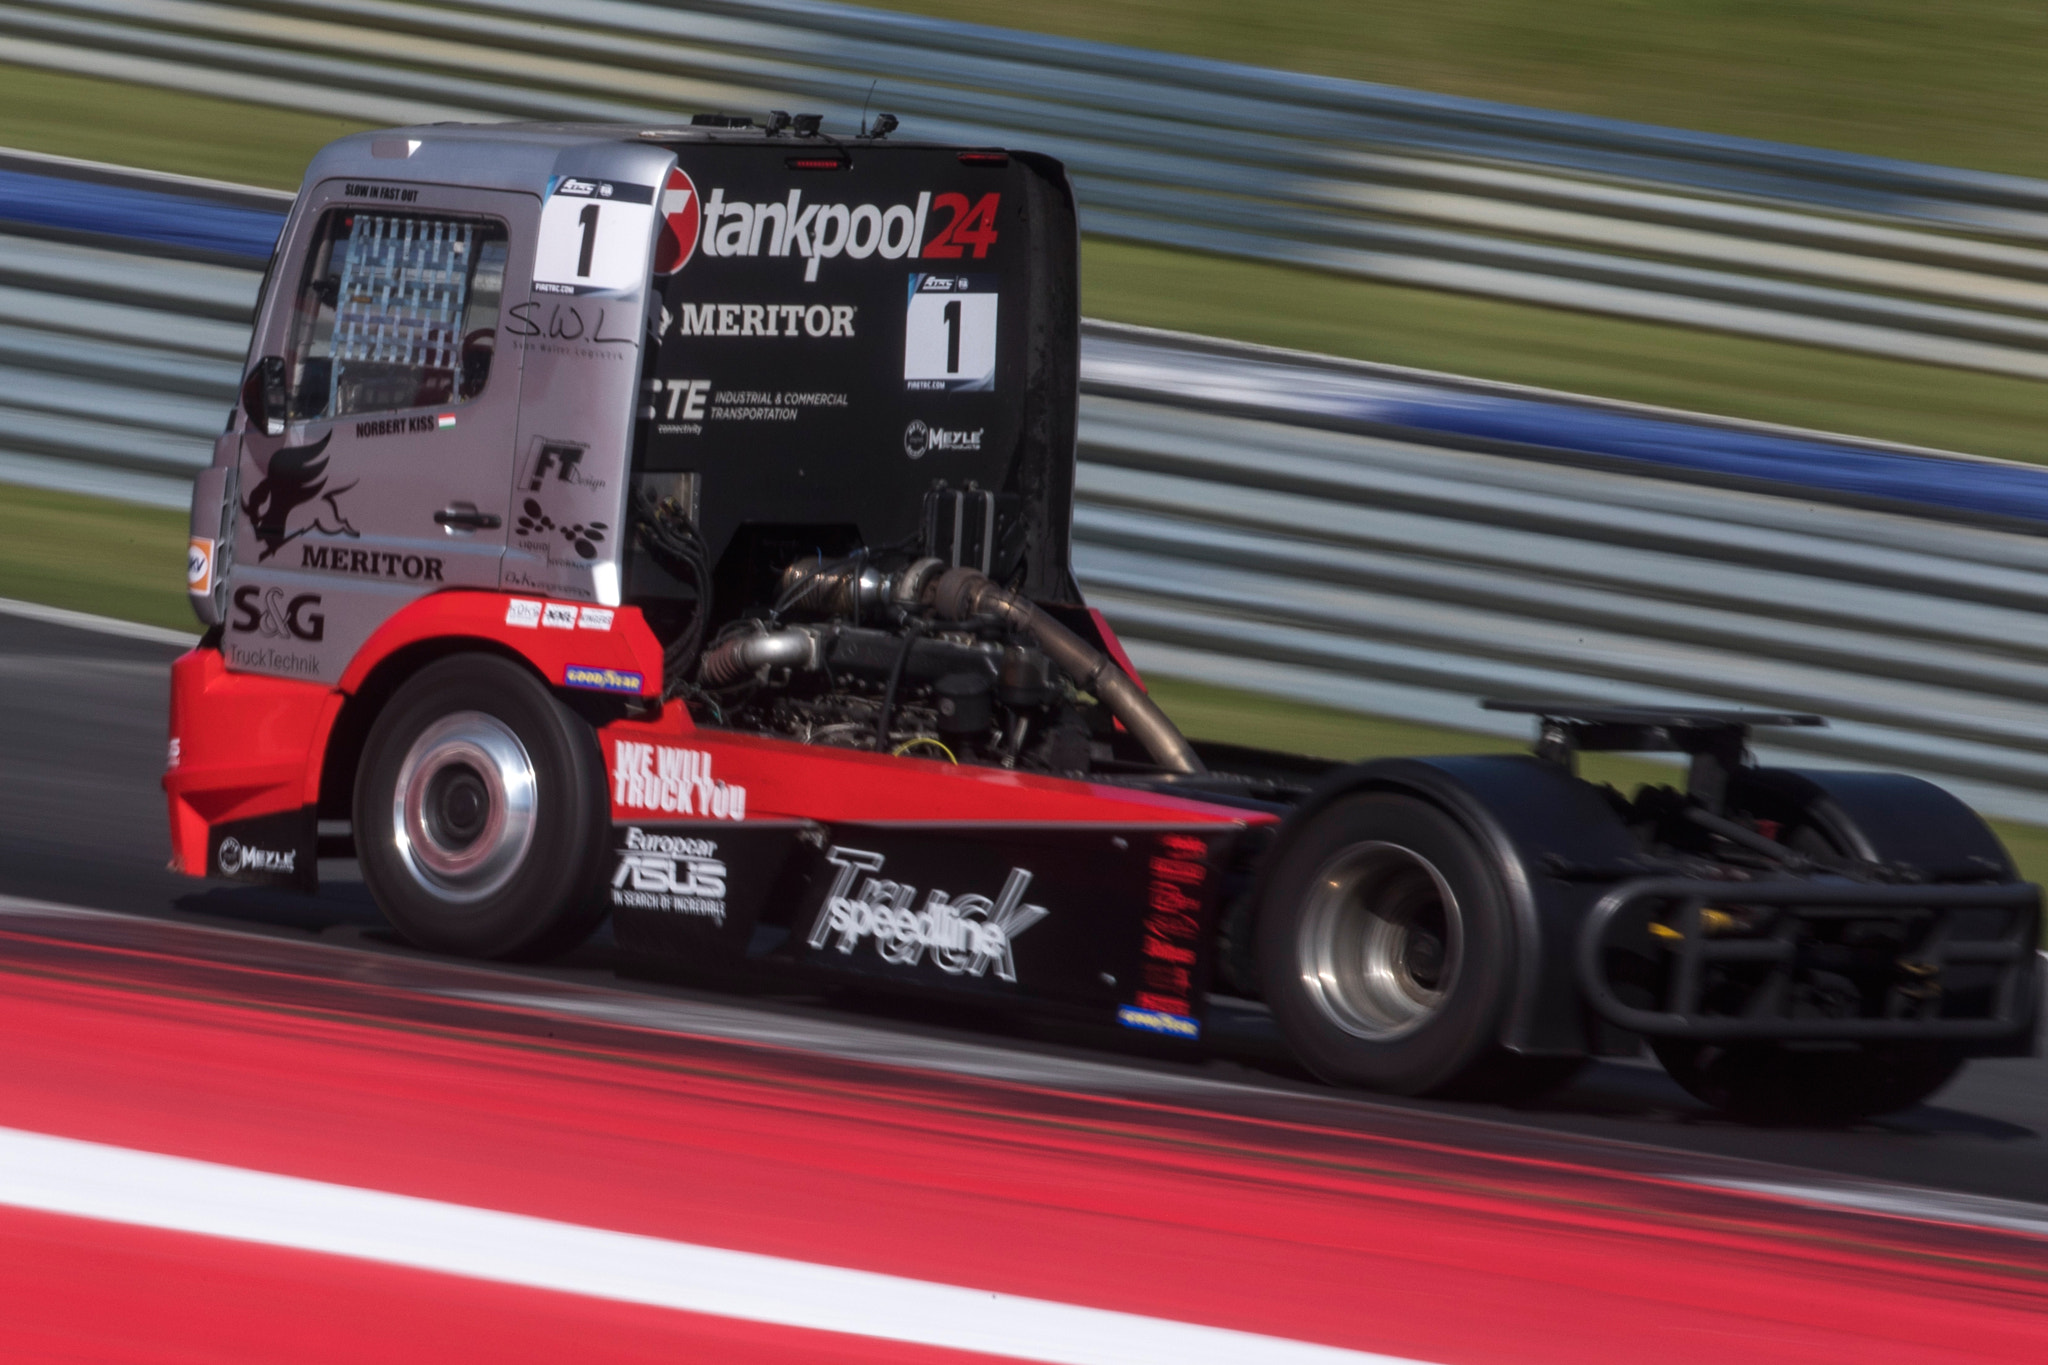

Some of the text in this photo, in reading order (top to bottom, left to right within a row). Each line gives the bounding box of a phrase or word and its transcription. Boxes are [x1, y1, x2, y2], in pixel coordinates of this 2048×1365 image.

[345, 183, 419, 203] SLOW IN FAST OUT
[577, 204, 600, 278] 1
[681, 303, 855, 338] MERITOR
[944, 300, 962, 374] 1
[711, 407, 798, 421] TRANSPORTATION
[715, 391, 848, 406] INDUSTRIAL & COMMERCIAL
[356, 415, 434, 438] NORBERT KISS
[301, 545, 444, 581] MERITOR
[232, 585, 325, 643] S&G
[615, 740, 712, 784] WE WILL
[613, 768, 746, 821] TRUCK YOU
[611, 857, 727, 898] ASUS
[611, 888, 727, 918] IN SEARCH OF INCREDIBLE
[829, 895, 1006, 957] speedline
